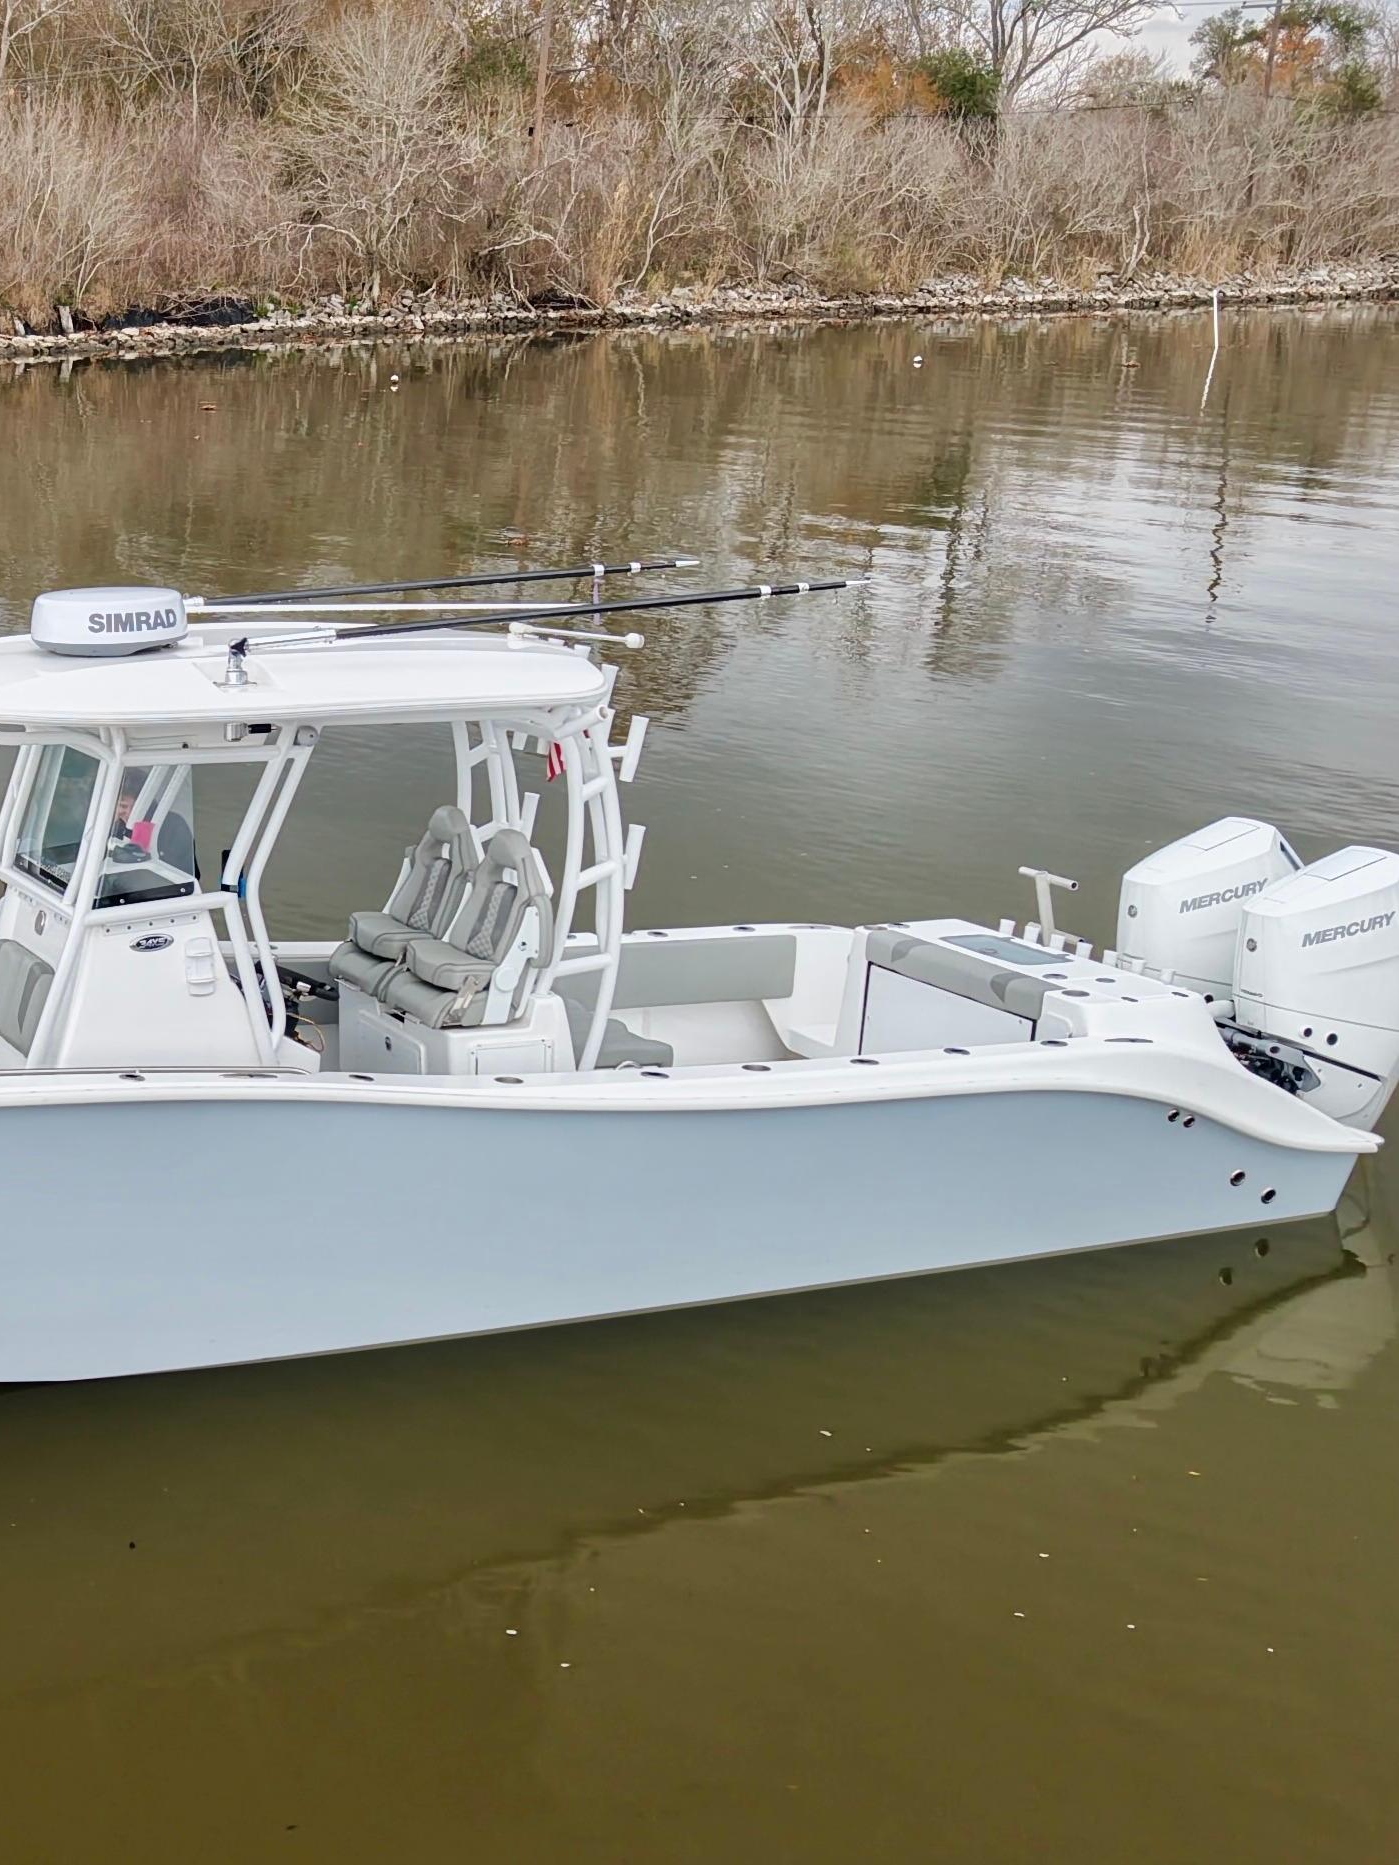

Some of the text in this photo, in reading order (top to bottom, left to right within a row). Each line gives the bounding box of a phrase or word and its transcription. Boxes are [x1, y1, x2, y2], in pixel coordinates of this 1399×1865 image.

[88, 608, 177, 633] SIMRAD
[1179, 878, 1268, 913] MERCURY
[1302, 911, 1396, 947] MERCURY
